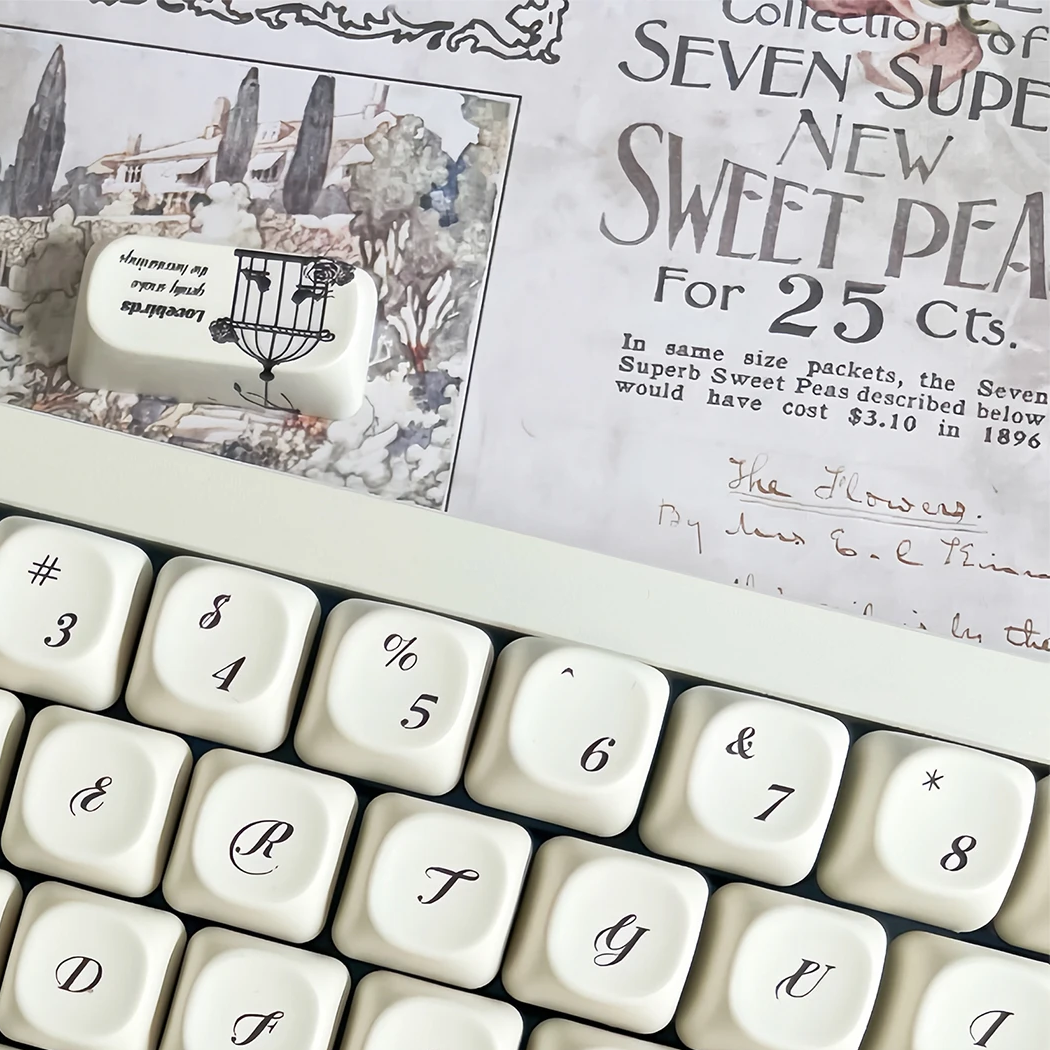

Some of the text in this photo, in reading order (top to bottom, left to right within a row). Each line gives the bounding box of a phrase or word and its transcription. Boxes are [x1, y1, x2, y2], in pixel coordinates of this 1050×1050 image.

[988, 26, 1049, 58] of
[654, 266, 745, 310] For
[768, 273, 887, 344] 25
[622, 333, 1049, 405] In same size packets, the Seven
[619, 356, 1046, 426] Superb Sweet Peas described below
[615, 380, 1042, 449] would have cost $3.10 in 1896
[28, 555, 61, 586] #
[44, 613, 77, 647] 3
[384, 634, 417, 671] %
[212, 657, 246, 692] 4
[401, 694, 438, 729] 5
[581, 737, 615, 772] 6
[726, 727, 755, 759] &
[754, 784, 795, 821] 7
[230, 820, 294, 875] R
[940, 835, 976, 871] 8
[56, 956, 102, 992] D
